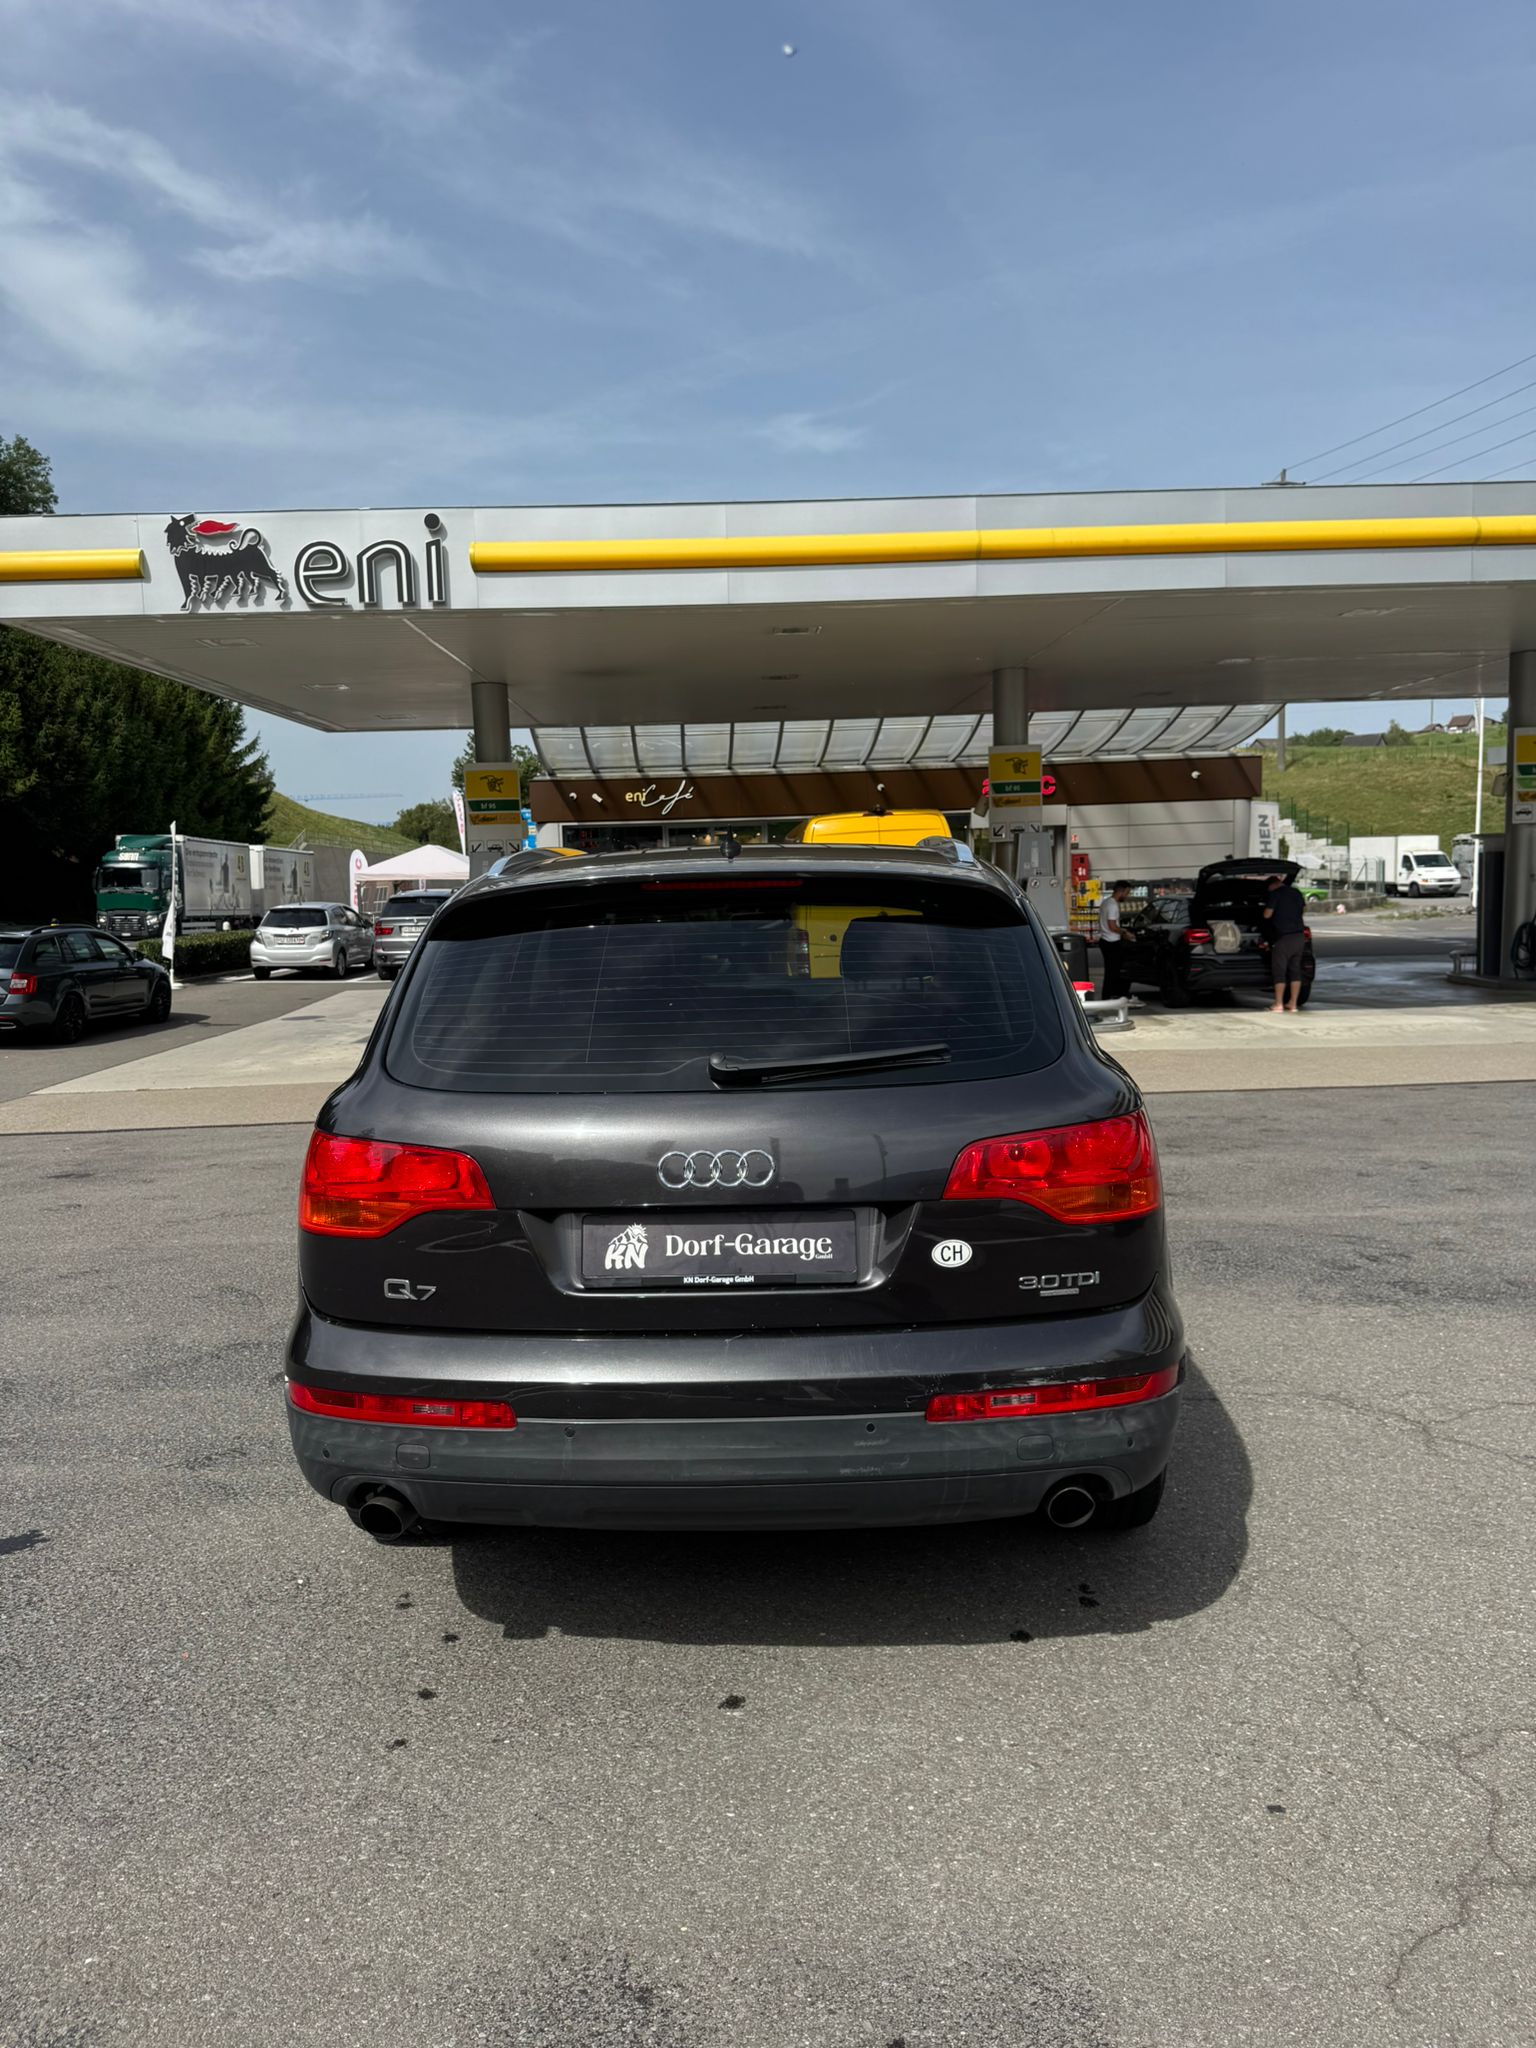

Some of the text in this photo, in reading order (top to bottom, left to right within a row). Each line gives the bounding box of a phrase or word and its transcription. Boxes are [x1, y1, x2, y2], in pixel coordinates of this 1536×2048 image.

[294, 513, 446, 604] eni
[604, 1243, 649, 1270] KN
[665, 1233, 832, 1261] Dorf-Garage
[940, 1245, 963, 1262] CH
[384, 1278, 437, 1300] Q7
[683, 1275, 755, 1285] KN Dorf-Garage GmbH
